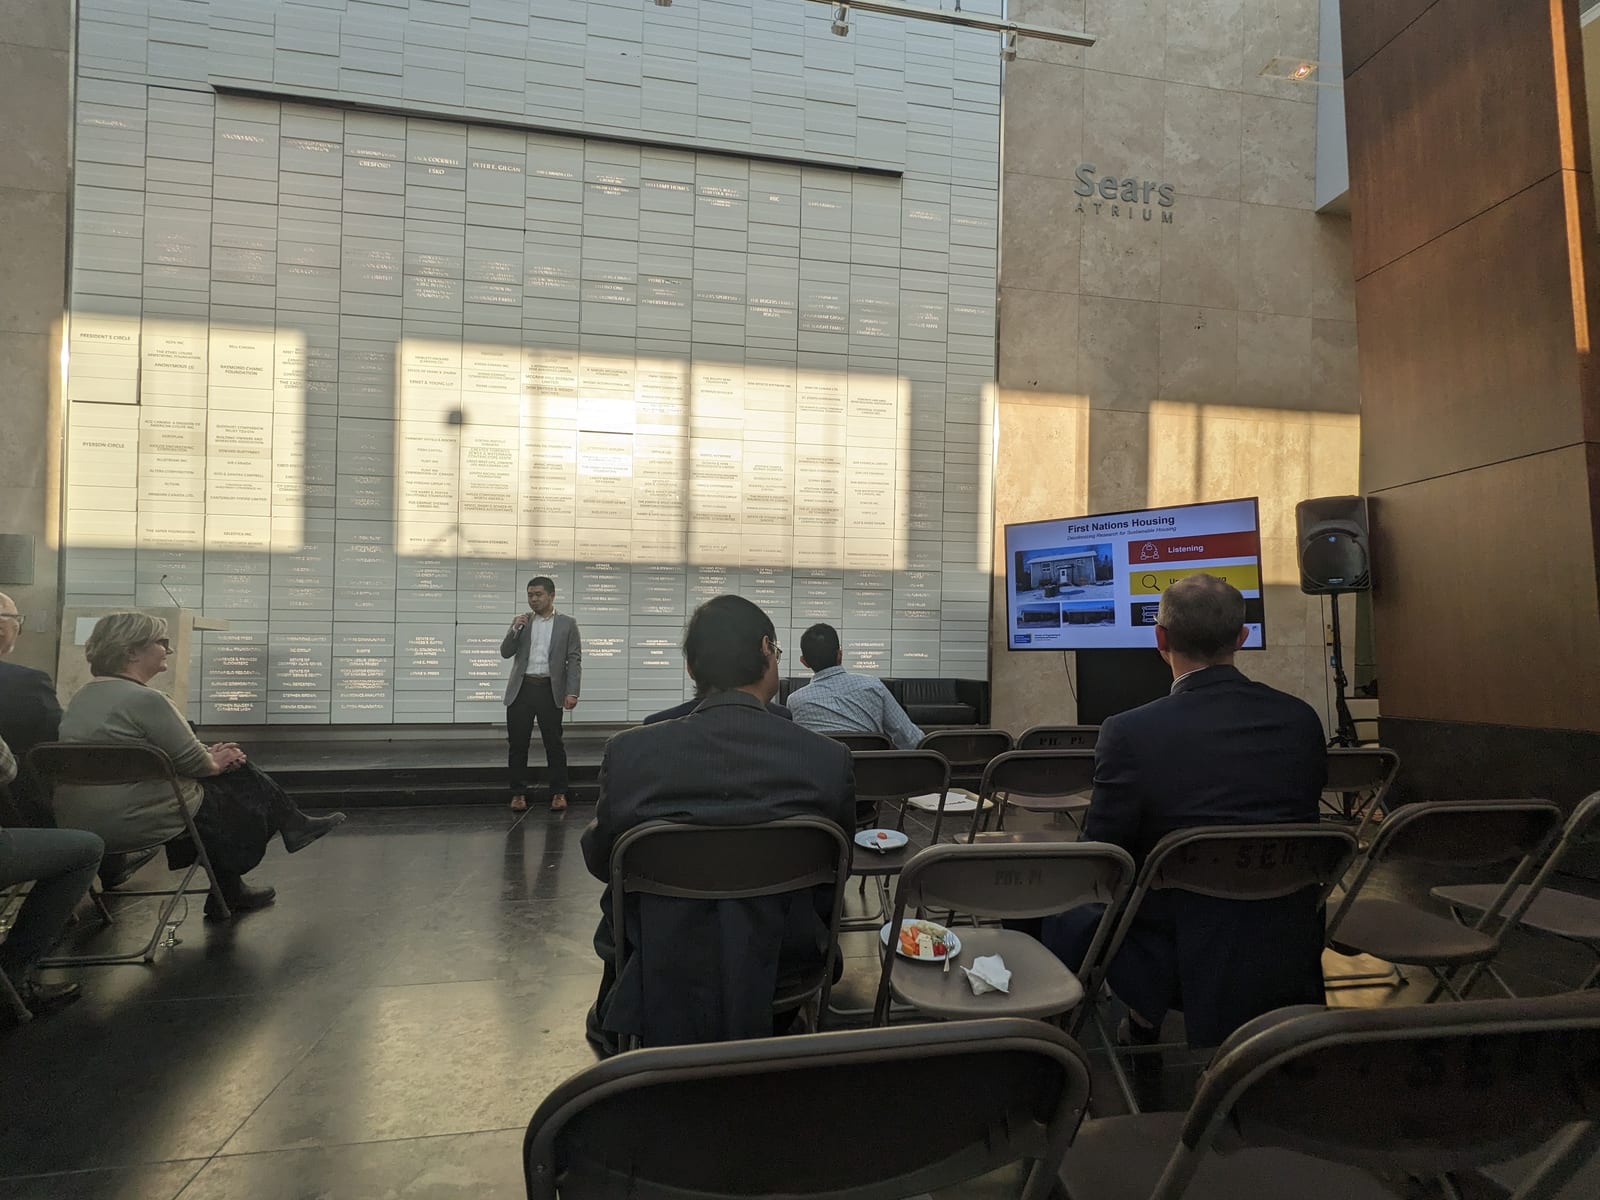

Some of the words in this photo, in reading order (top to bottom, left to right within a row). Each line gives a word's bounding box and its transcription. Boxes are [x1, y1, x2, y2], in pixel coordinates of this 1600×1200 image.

[1073, 162, 1175, 207] Sears
[1074, 202, 1173, 224] ATRIUM
[1068, 524, 1089, 533] First
[1092, 520, 1128, 531] Nations
[1132, 516, 1175, 528] Housing
[1168, 545, 1204, 553] Listening
